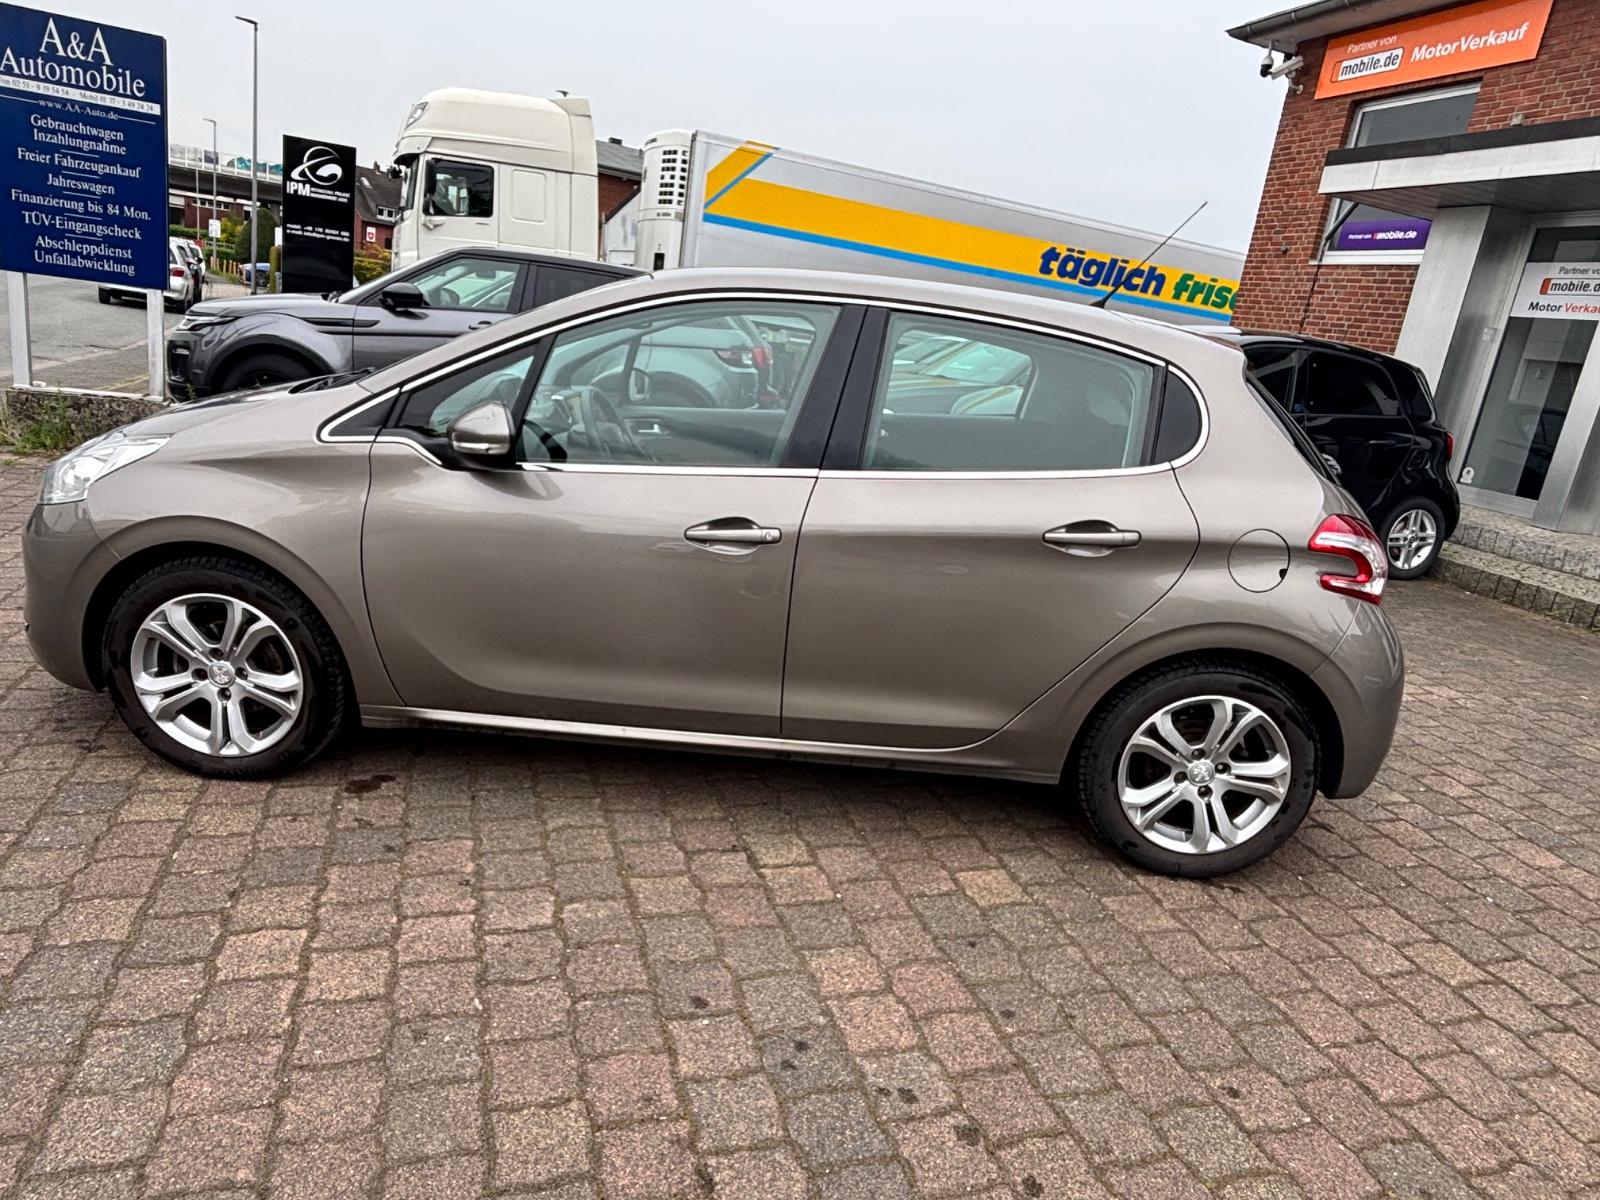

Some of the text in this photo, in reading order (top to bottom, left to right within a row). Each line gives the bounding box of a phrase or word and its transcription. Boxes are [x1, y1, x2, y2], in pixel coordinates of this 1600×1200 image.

[39, 17, 114, 66] A&A
[1347, 35, 1397, 53] Partner von
[0, 47, 145, 97] Automobile
[1340, 52, 1399, 77] mobile.de
[30, 114, 124, 142] Gebrauchtwagen
[34, 129, 126, 155] Inzahlungnahme
[17, 147, 141, 178] Freier Fahrzeugankauf
[47, 174, 115, 195] Jahreswagen
[286, 181, 311, 197] IPM
[11, 189, 151, 220] Finanzierung bis 84 Mon.
[22, 210, 142, 240] TÜV-Eingangscheck
[1376, 230, 1417, 240] mobile.de
[35, 235, 132, 259] Abschleppdienst
[34, 250, 135, 277] Unfallabwicklung
[1039, 246, 1167, 297] täglich
[1558, 266, 1591, 275] Partner
[1528, 301, 1563, 313] Motor
